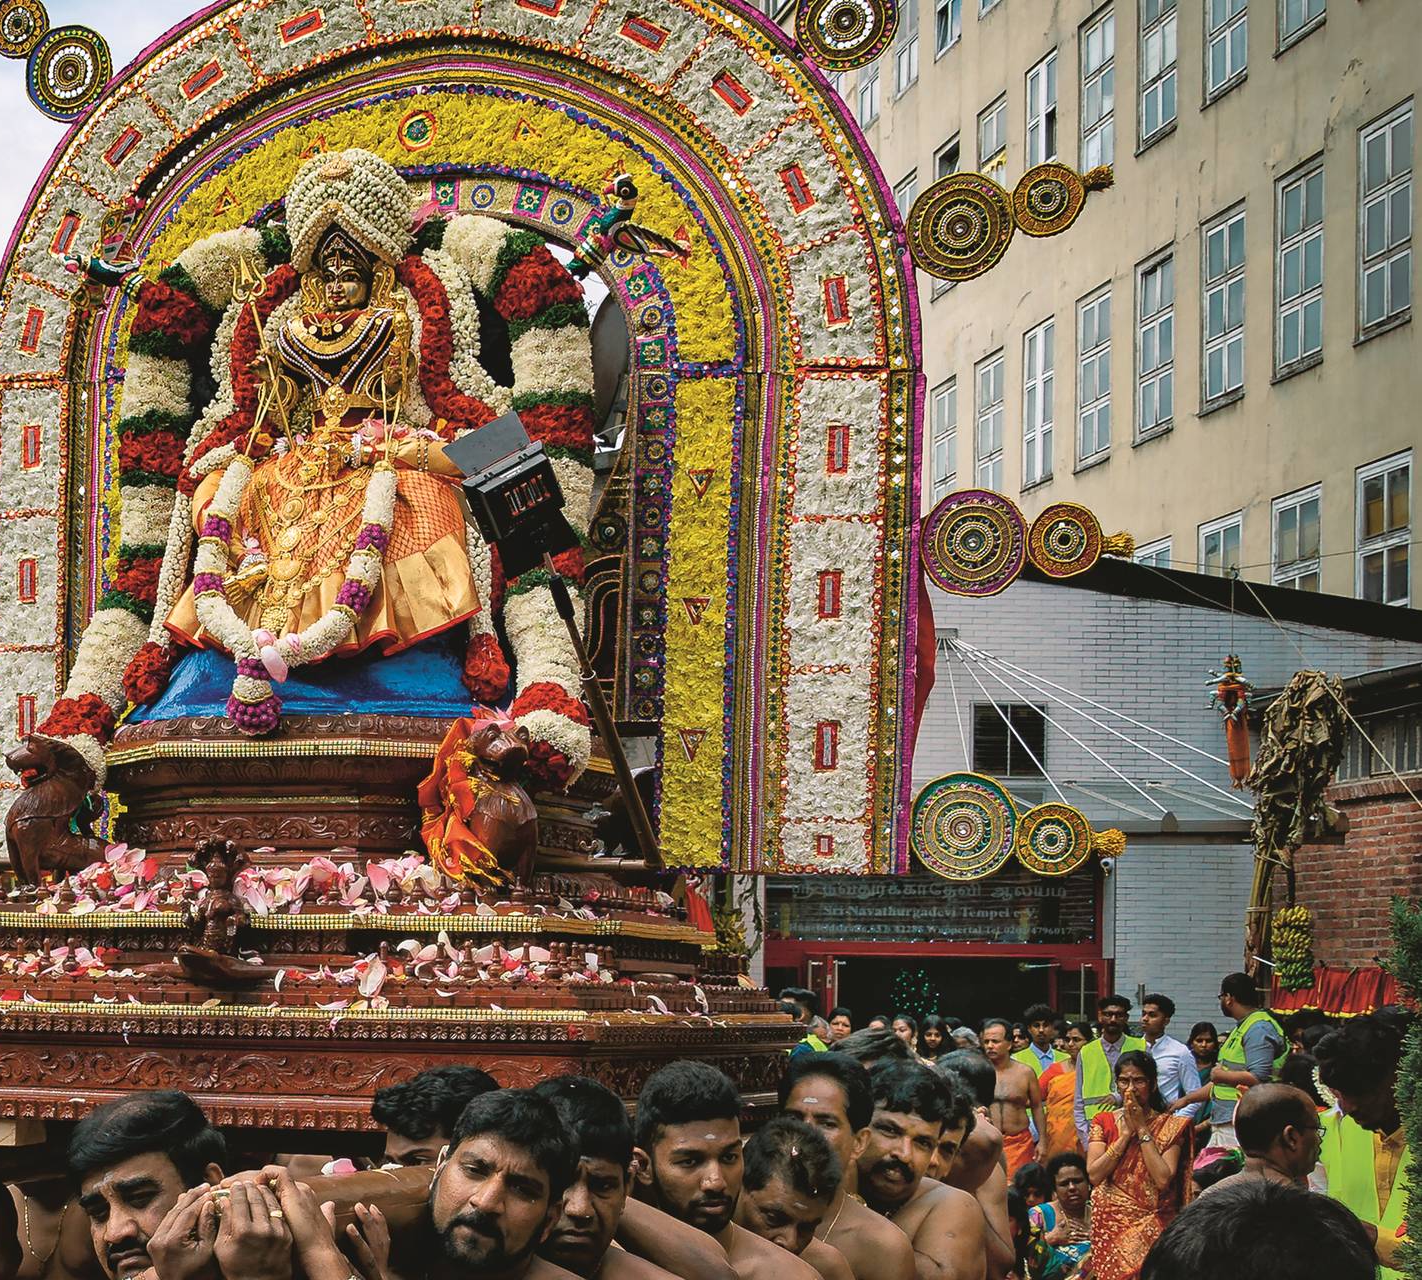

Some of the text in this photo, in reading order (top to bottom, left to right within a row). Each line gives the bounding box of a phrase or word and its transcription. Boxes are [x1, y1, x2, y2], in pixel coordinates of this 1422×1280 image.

[824, 905, 844, 916] Sri
[847, 905, 956, 919] Navathurgadevi
[960, 907, 1010, 920] Tempel
[927, 924, 981, 936] Wuppertal
